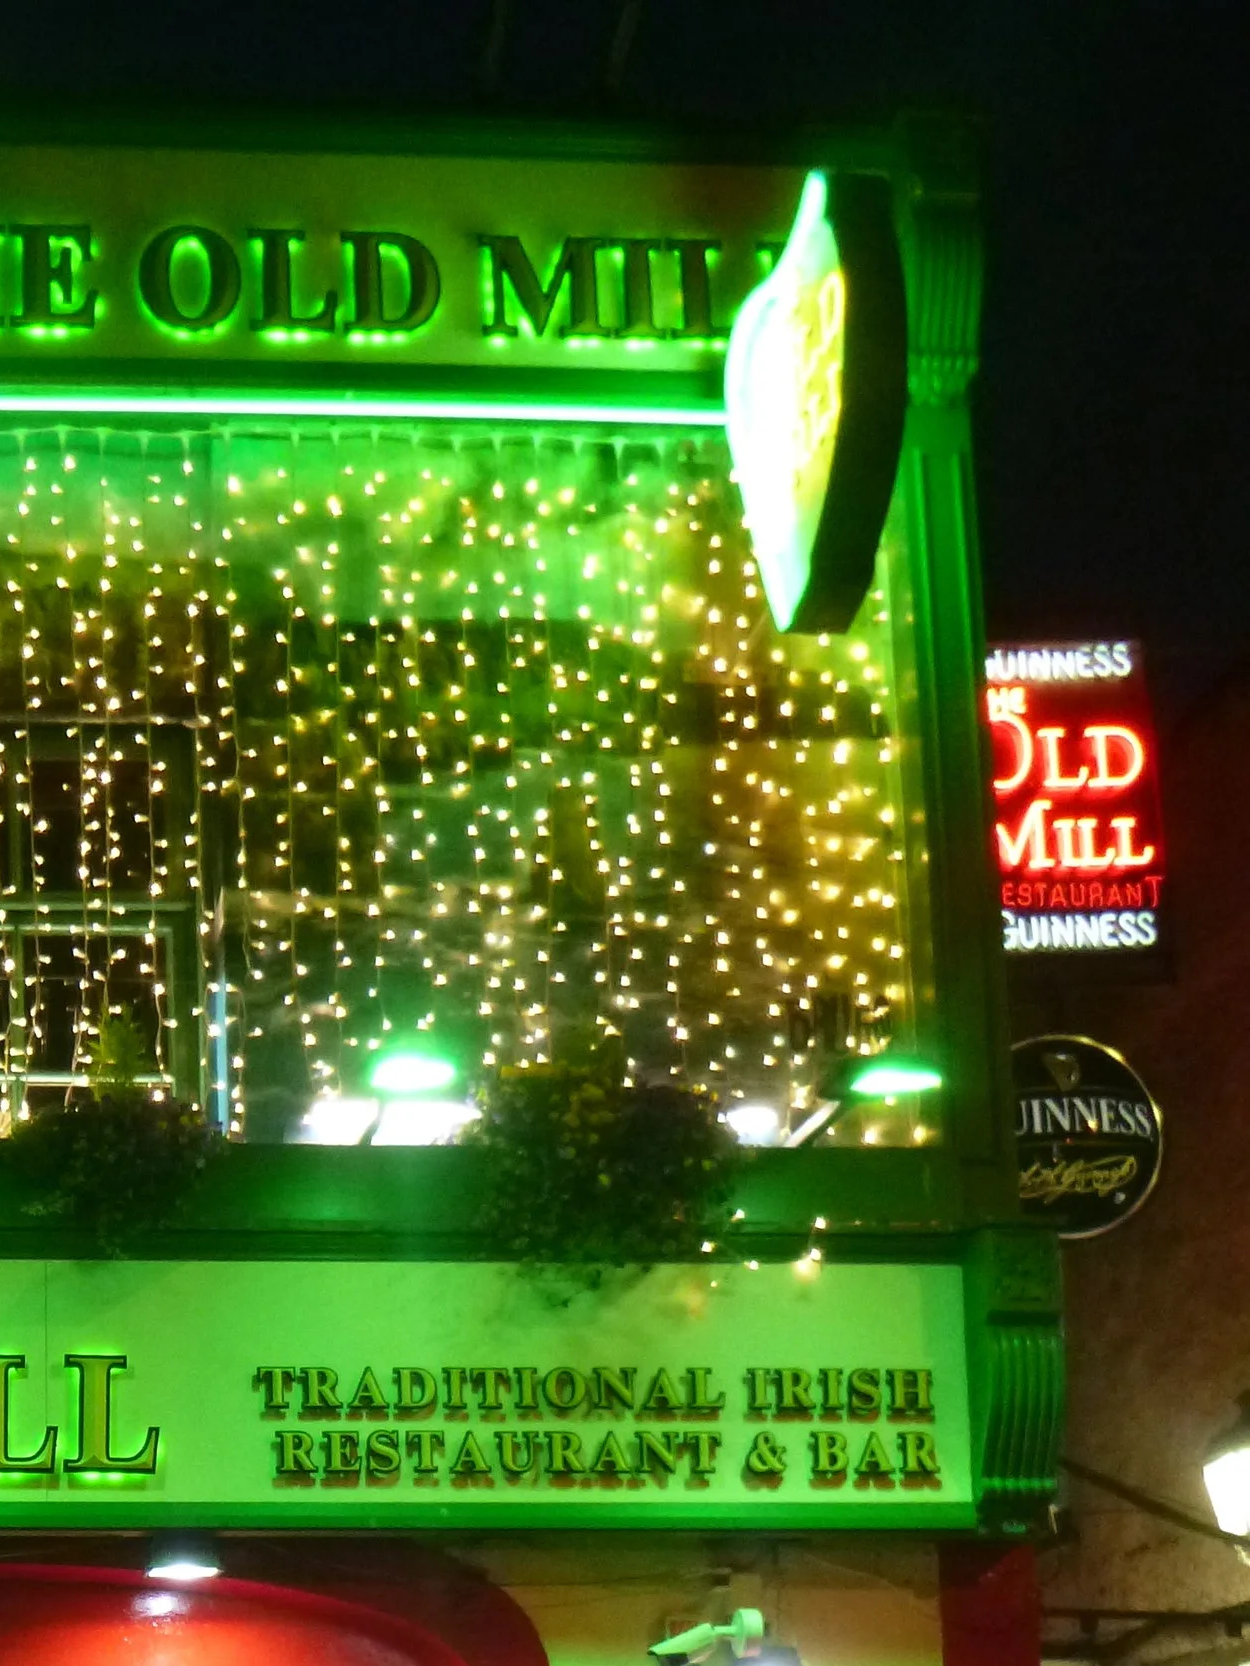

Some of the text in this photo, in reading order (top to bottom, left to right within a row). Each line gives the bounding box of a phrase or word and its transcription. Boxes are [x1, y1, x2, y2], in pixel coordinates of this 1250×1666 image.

[138, 226, 442, 335] OLD
[481, 232, 787, 341] MIL
[987, 687, 1026, 714] HE
[996, 799, 1154, 868] MILL
[1002, 876, 1164, 907] ESTAURANT
[1014, 1097, 1153, 1140] INNESS
[255, 1365, 933, 1412] TRADITIONAL IRISH
[275, 1429, 942, 1476] RESTAURANT & BAR
